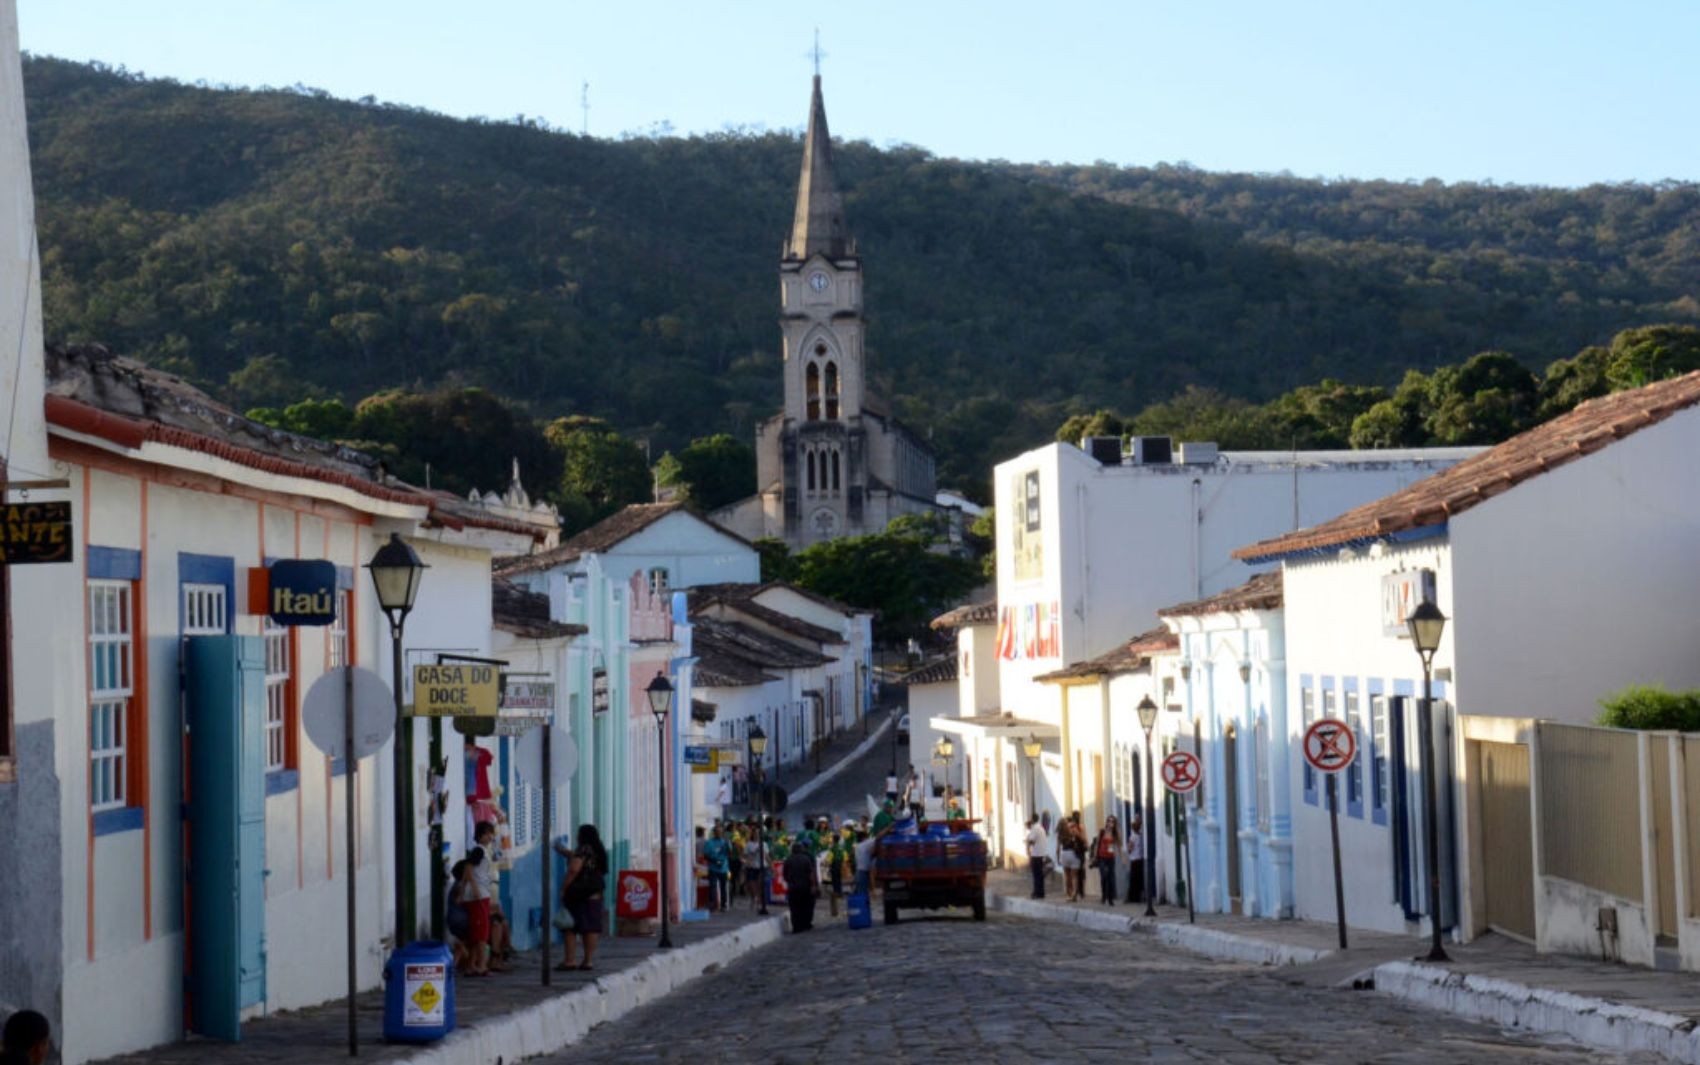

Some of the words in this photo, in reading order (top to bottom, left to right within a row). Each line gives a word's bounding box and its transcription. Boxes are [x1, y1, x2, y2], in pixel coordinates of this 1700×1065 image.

[274, 587, 331, 614] Itaú
[418, 667, 464, 684] CASA
[471, 667, 492, 684] DO
[429, 687, 468, 704] DOCE
